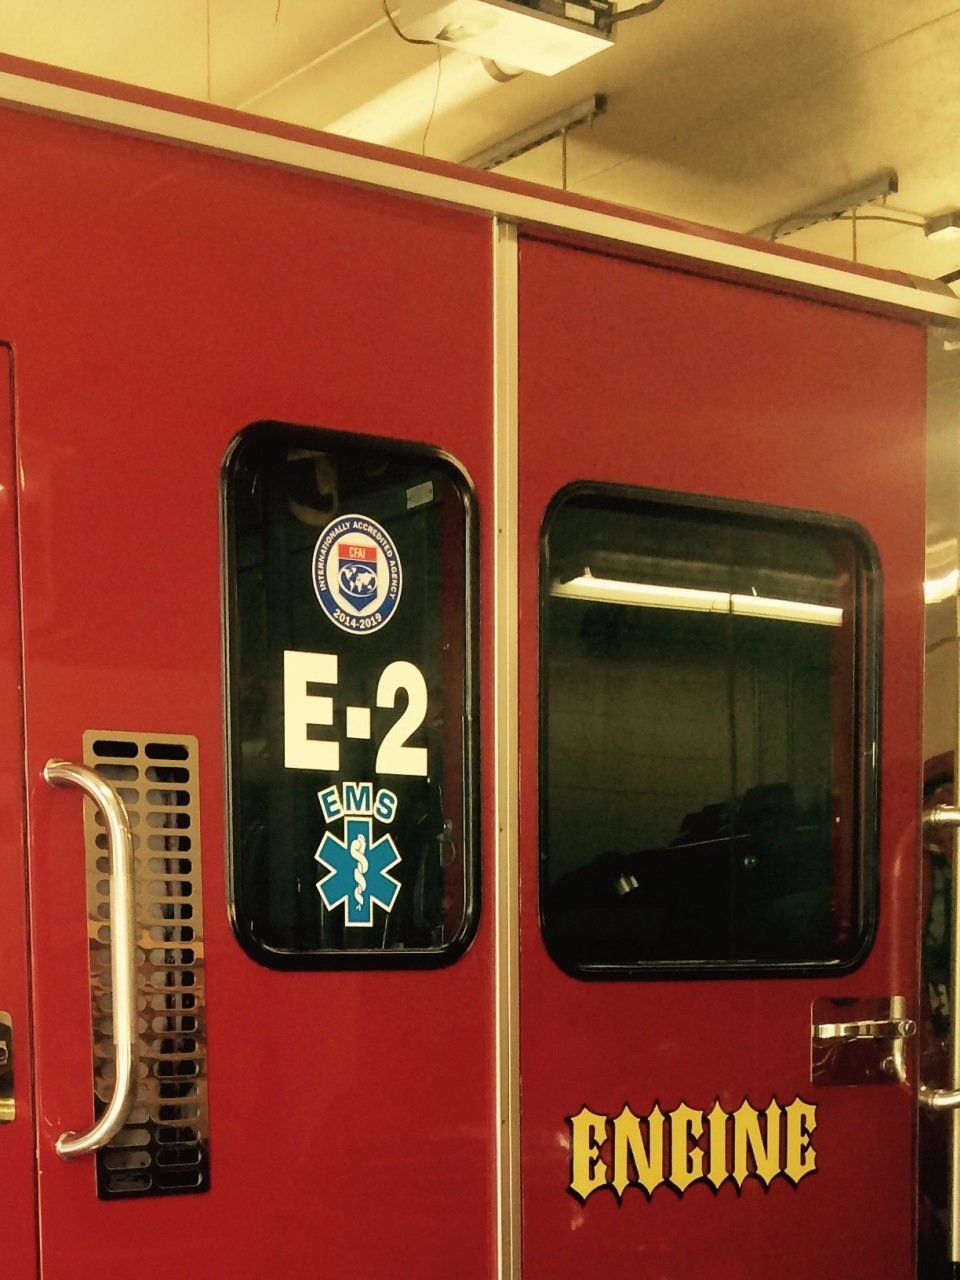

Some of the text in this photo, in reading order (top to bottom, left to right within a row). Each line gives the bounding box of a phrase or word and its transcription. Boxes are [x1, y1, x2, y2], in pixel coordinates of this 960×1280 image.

[316, 521, 398, 600] INTERNATIONALLY ACCREDITED AGENCY
[333, 609, 382, 628] 2014-2019
[284, 650, 428, 776] E-2
[318, 782, 398, 823] EMS
[566, 1094, 817, 1206] ENGINE
